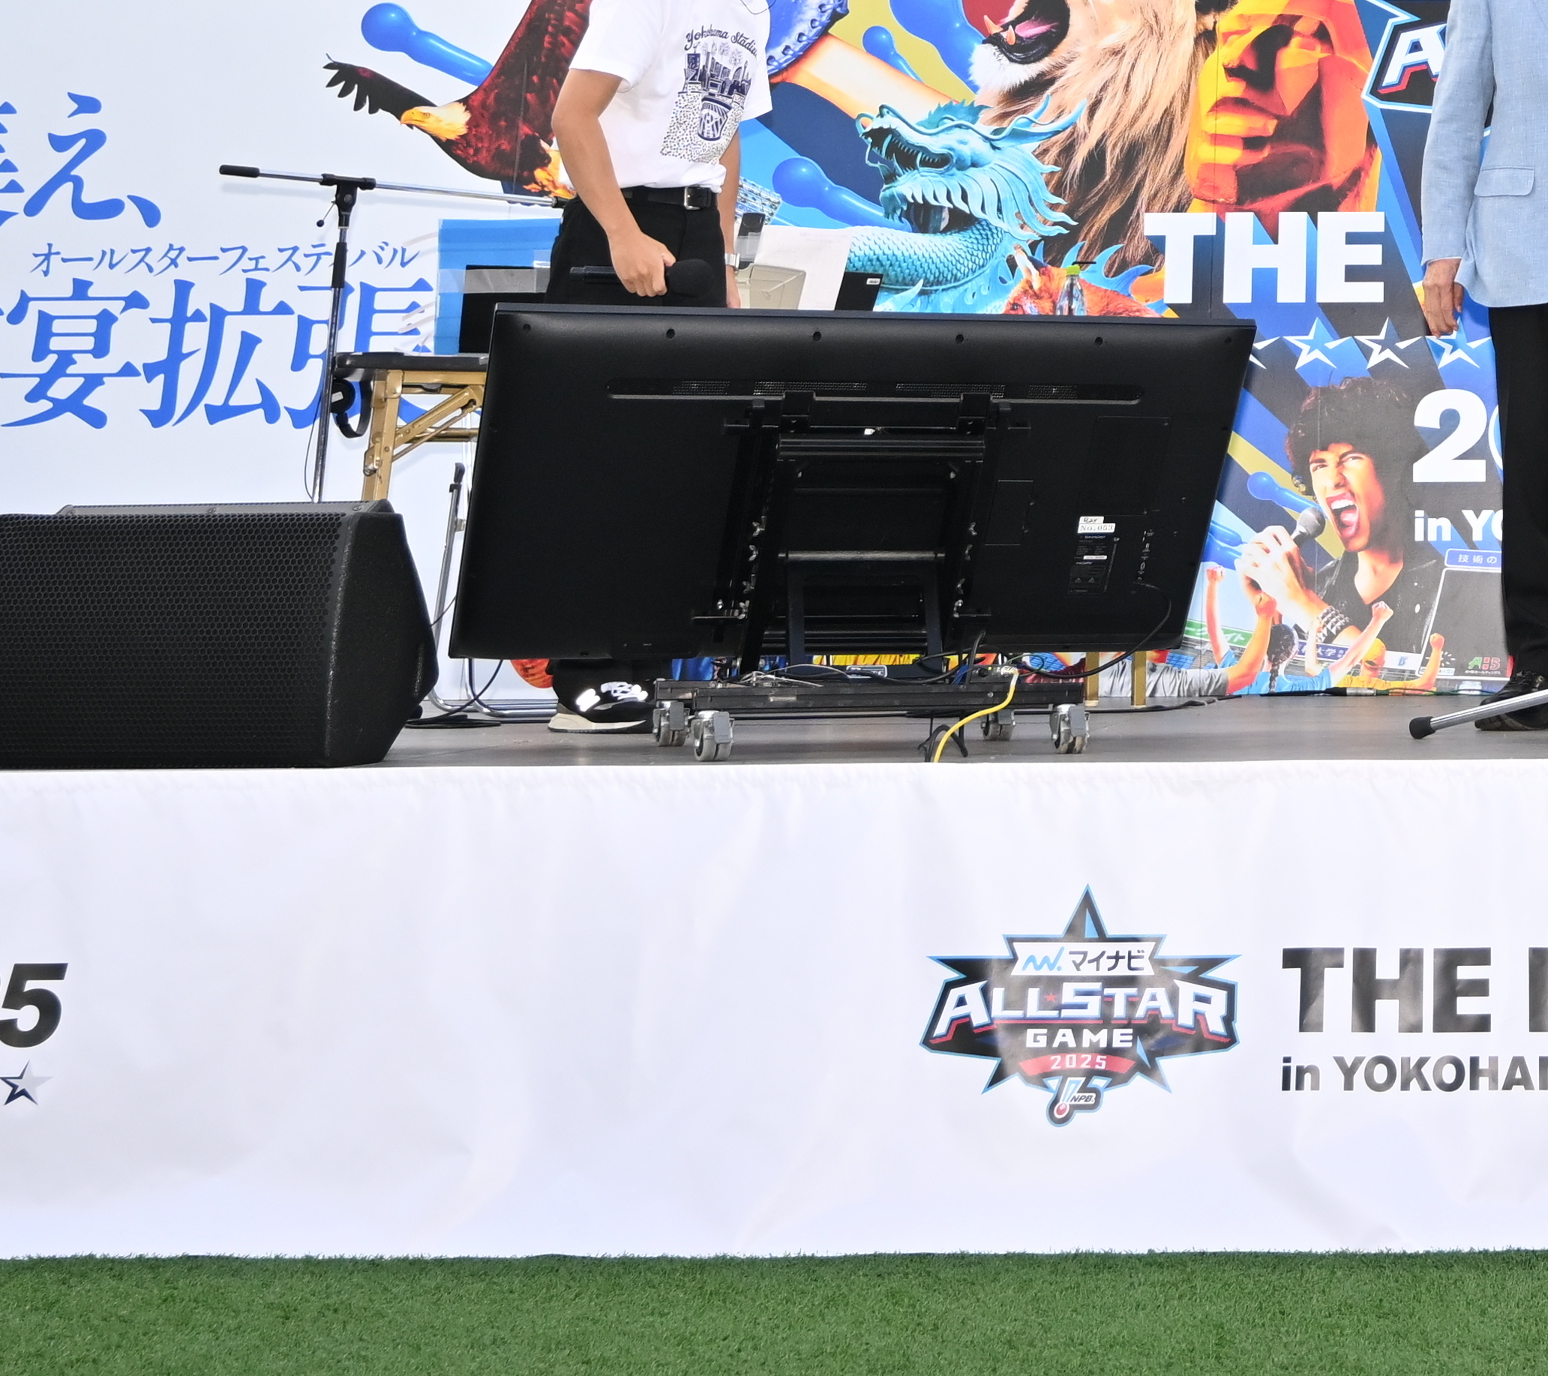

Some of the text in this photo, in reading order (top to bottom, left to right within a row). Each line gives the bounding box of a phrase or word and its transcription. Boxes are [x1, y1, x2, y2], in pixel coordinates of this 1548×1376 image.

[1143, 210, 1386, 305] THE
[1414, 509, 1452, 542] in
[1069, 949, 1145, 974] マイナビ
[1281, 947, 1492, 1034] THE
[1025, 1027, 1134, 1049] GAME
[1050, 1054, 1107, 1073] 2025
[1281, 1054, 1320, 1092] in
